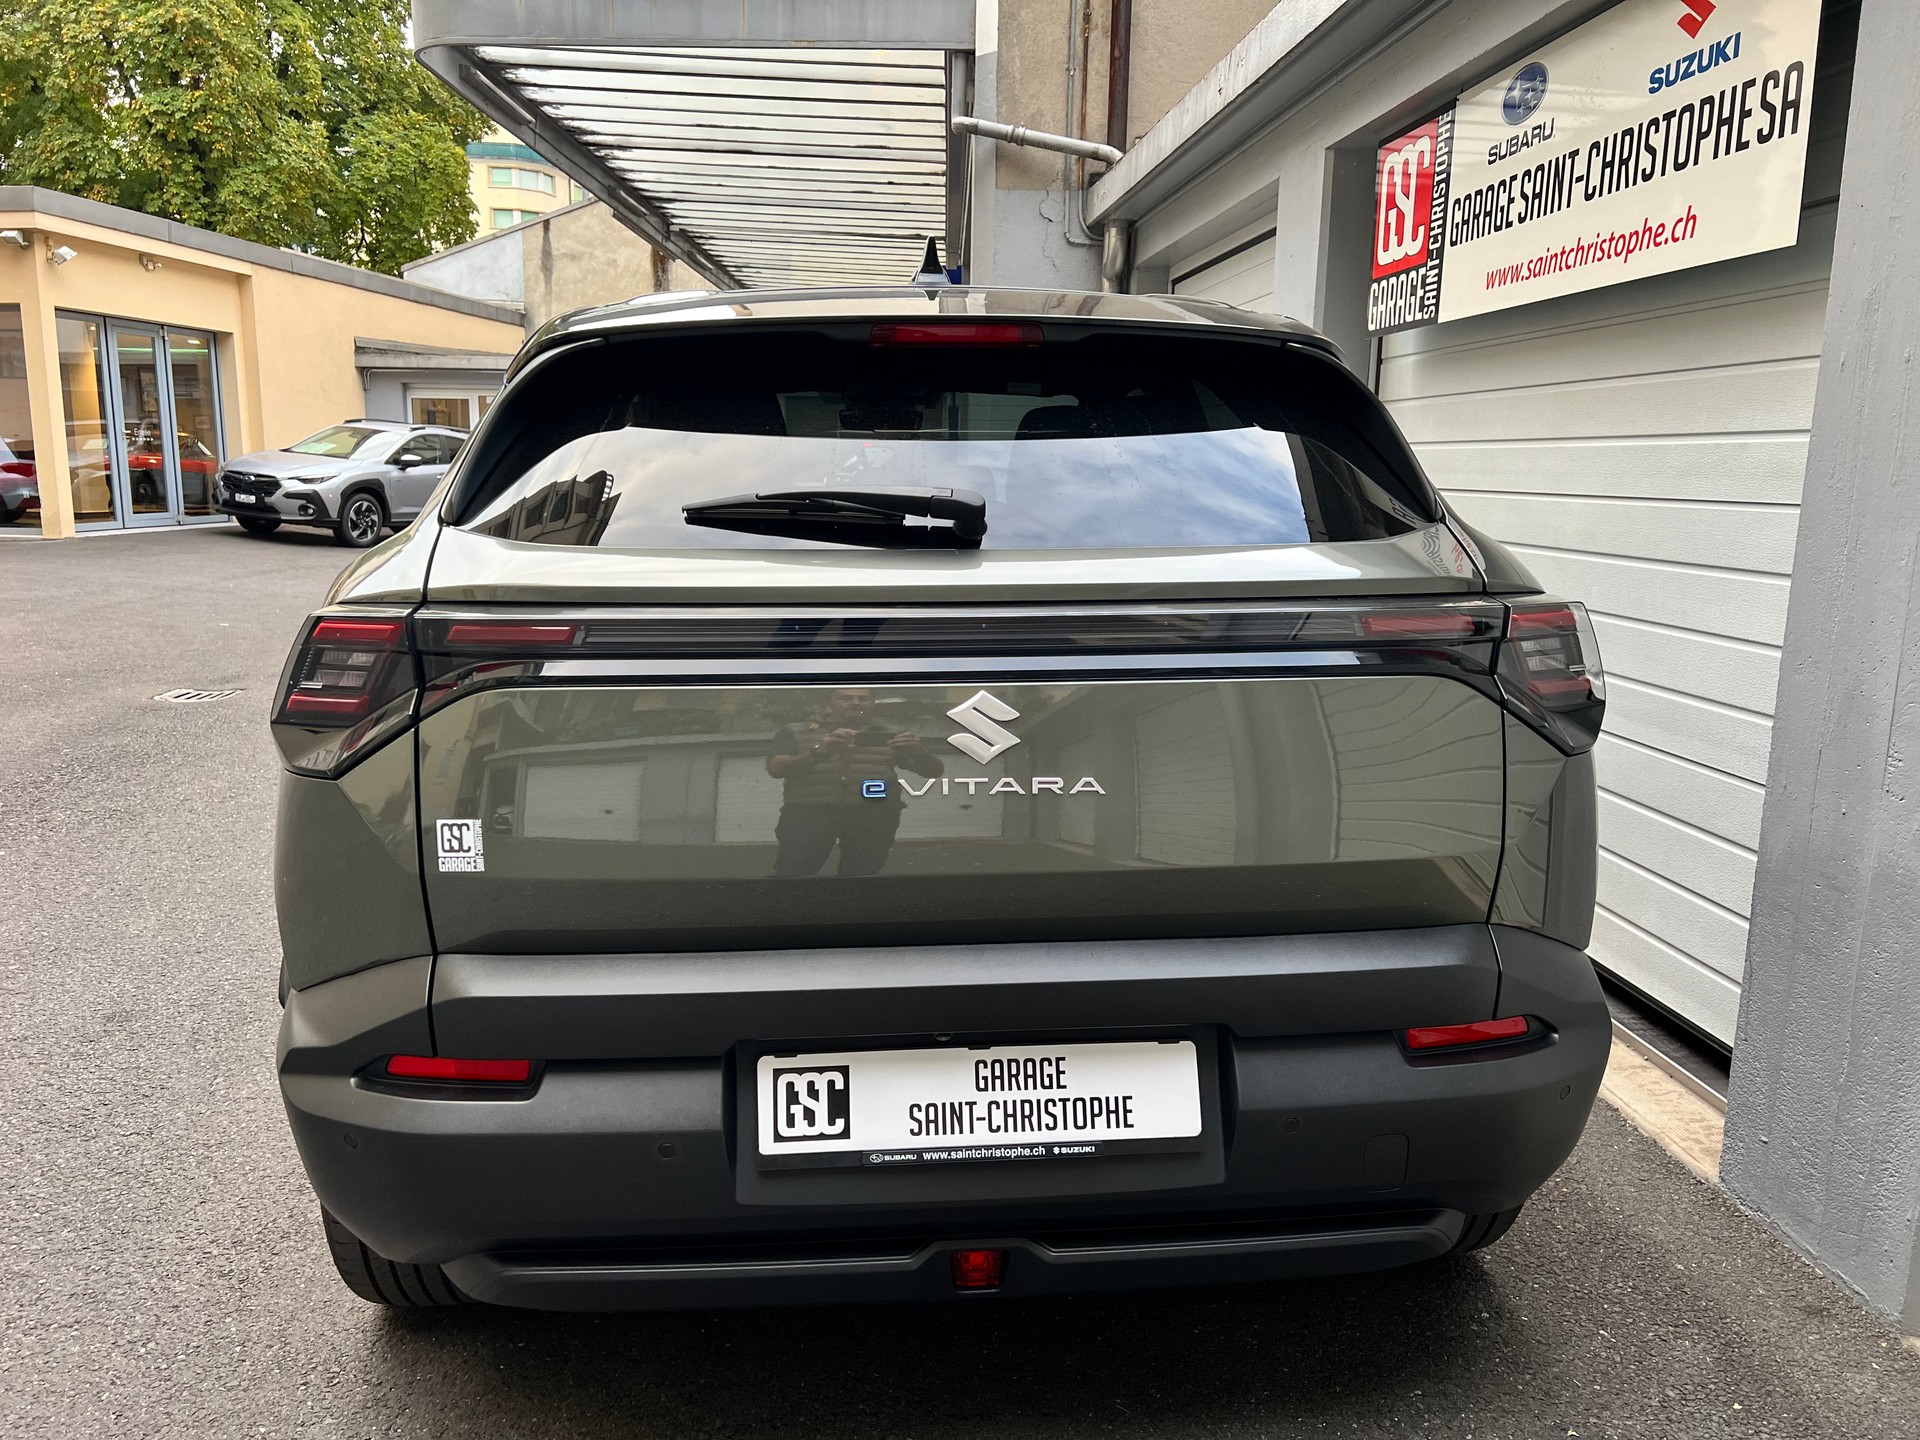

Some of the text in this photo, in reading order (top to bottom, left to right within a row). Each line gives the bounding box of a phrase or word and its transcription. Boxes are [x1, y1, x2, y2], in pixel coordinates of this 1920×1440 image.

[1648, 32, 1742, 95] SUZUKI
[1450, 60, 1804, 247] GARAGE SAINT-CHRISTOPHE SA
[1487, 118, 1555, 165] SUBARU
[1377, 135, 1431, 267] GSC
[1423, 109, 1452, 320] SAINT-CHRISTOPHE
[1485, 205, 1697, 290] www.saintchristophe.ch
[1367, 267, 1427, 331] GARAGE
[897, 777, 1106, 796] VITARA
[438, 857, 477, 872] GARAGE
[440, 822, 472, 853] GSC
[974, 1057, 1067, 1093] GARAGE
[775, 1071, 845, 1137] GSC
[909, 1096, 1134, 1136] SAINT-CHRISTOPHE
[884, 1145, 1096, 1161] SUBARU www.saintchristophe.ch SUZUKI
